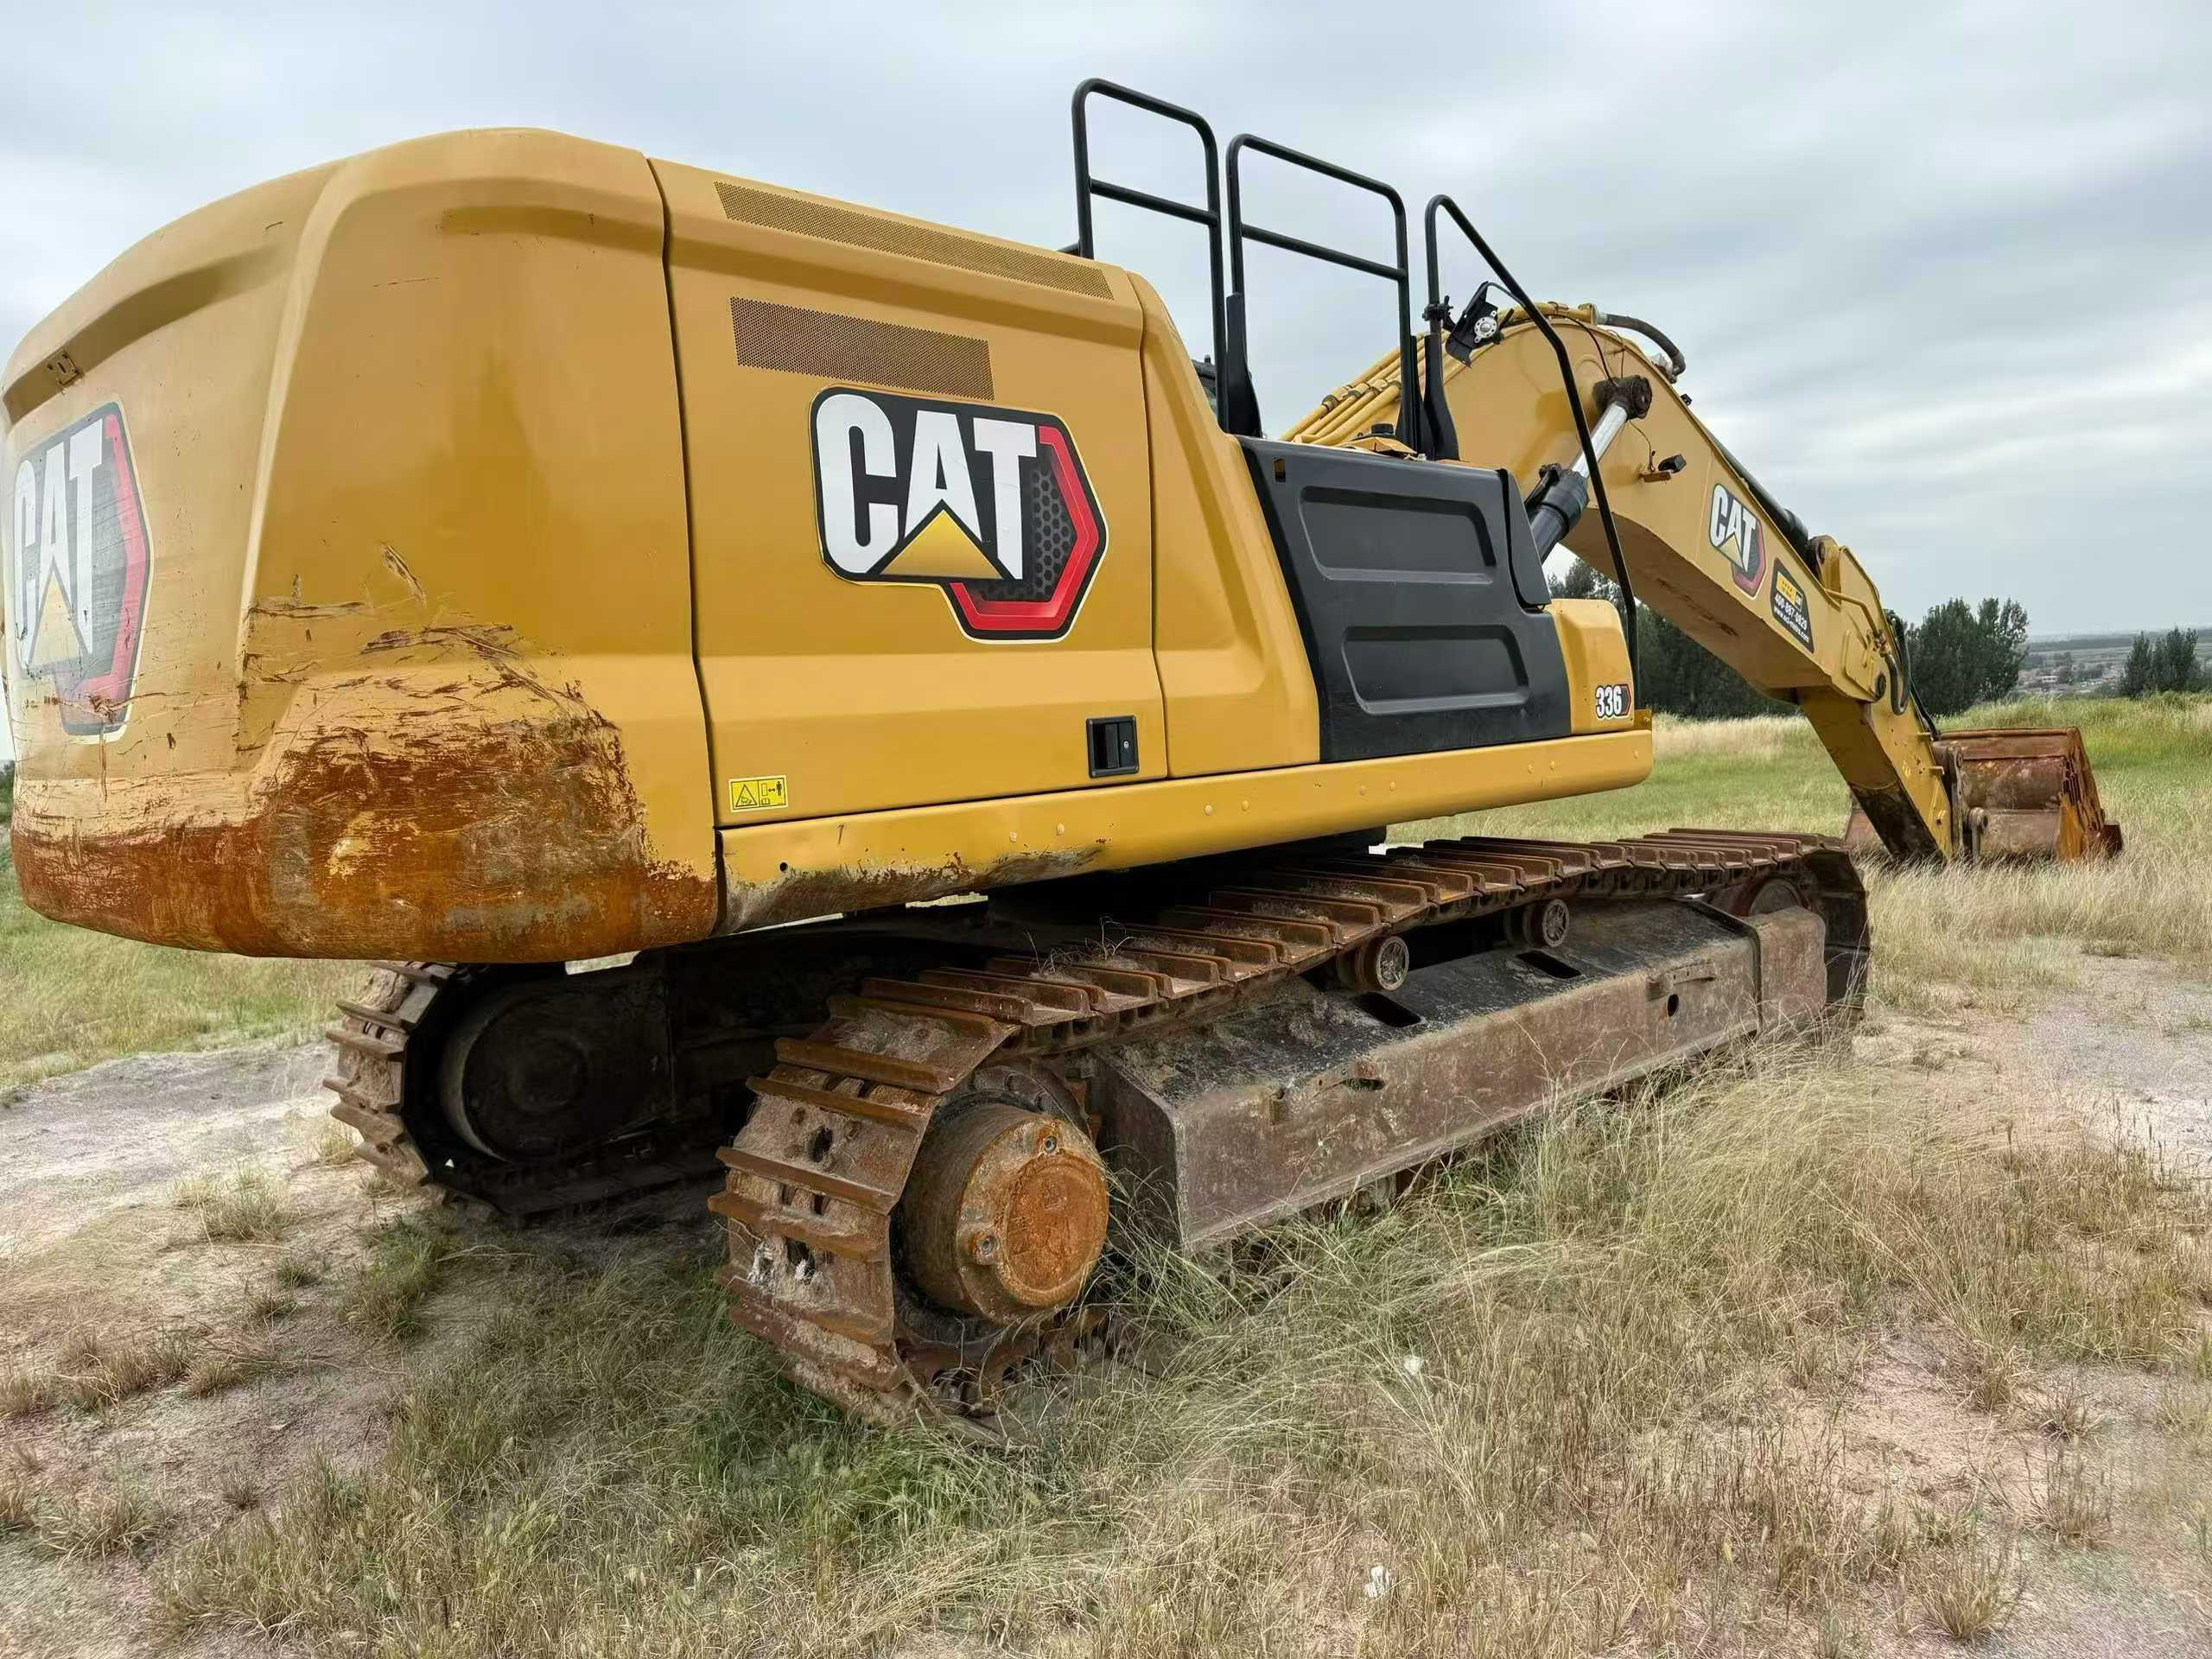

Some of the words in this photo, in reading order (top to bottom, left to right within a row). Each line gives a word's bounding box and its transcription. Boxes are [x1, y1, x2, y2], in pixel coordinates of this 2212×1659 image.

[14, 418, 103, 669] CAT
[817, 393, 1037, 580] CAT
[1711, 484, 1757, 572] CAT
[1595, 685, 1623, 717] 336
